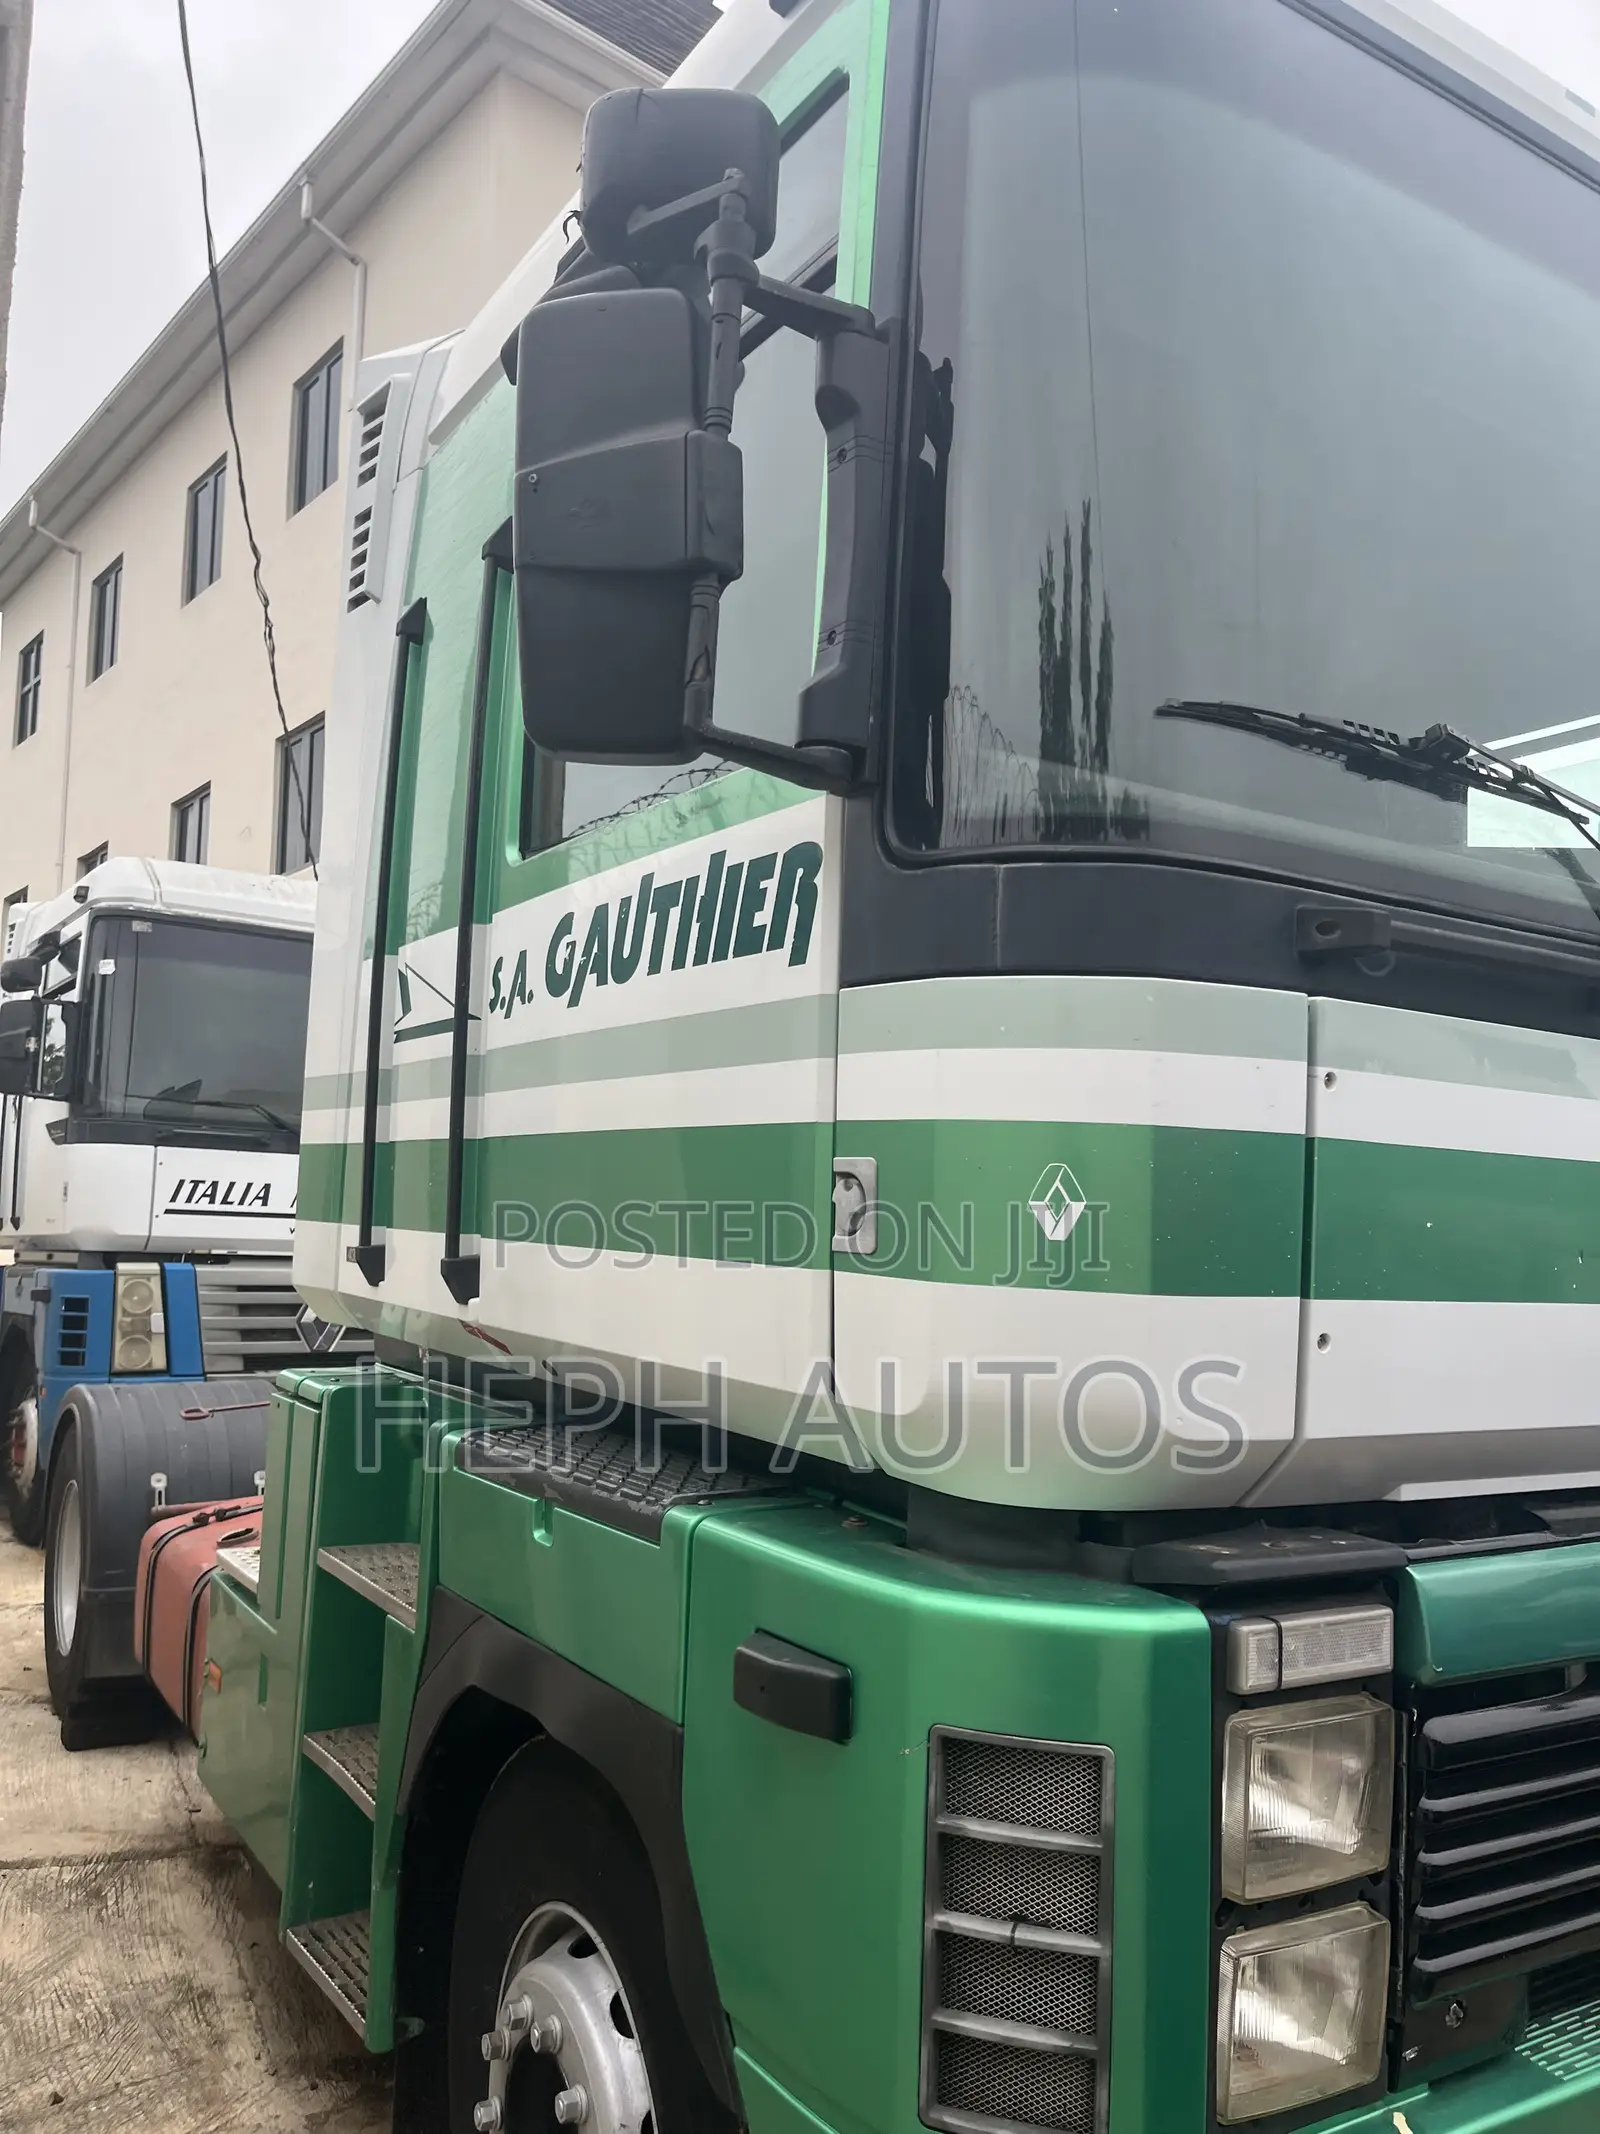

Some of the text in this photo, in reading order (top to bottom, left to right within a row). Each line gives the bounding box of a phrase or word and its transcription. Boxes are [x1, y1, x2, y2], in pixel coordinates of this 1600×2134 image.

[489, 841, 824, 1019] S.A. GAUTHIER
[169, 1179, 272, 1207] ITALIA
